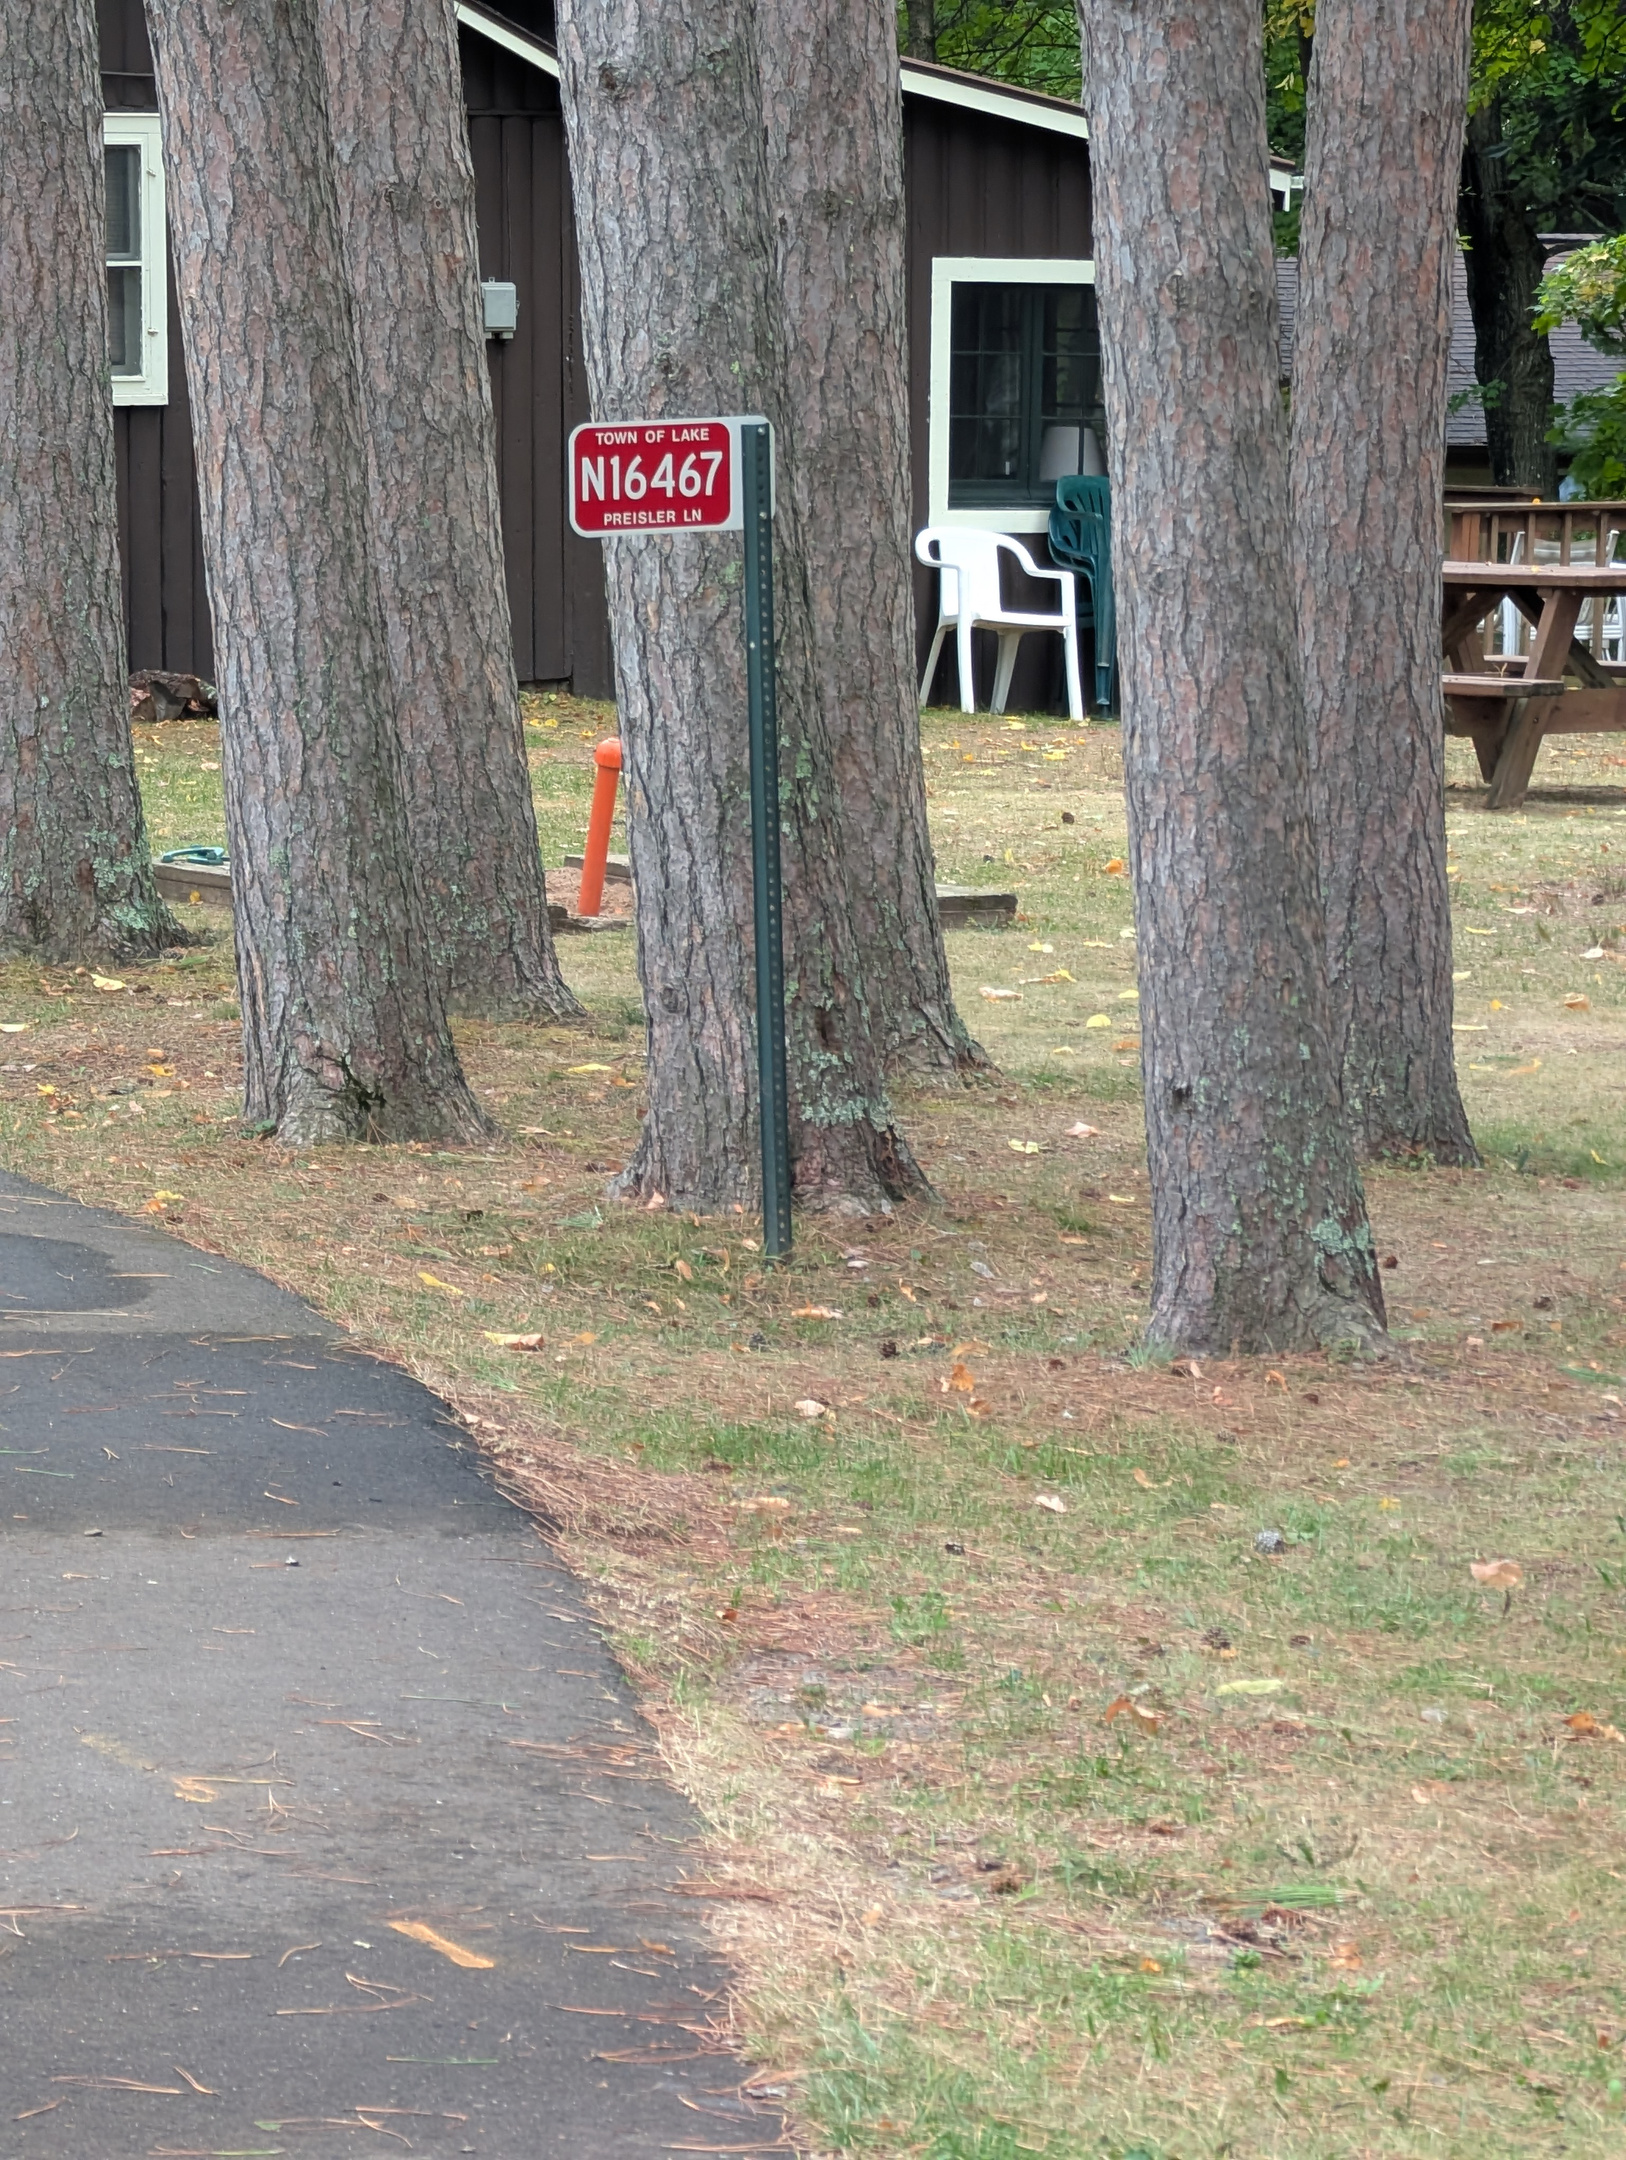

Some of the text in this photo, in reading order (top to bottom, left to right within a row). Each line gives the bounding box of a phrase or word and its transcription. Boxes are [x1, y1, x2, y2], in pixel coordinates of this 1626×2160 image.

[595, 428, 710, 446] TOWN OF LAKE
[581, 451, 723, 502] N16467
[603, 509, 702, 526] PREISLER LN
